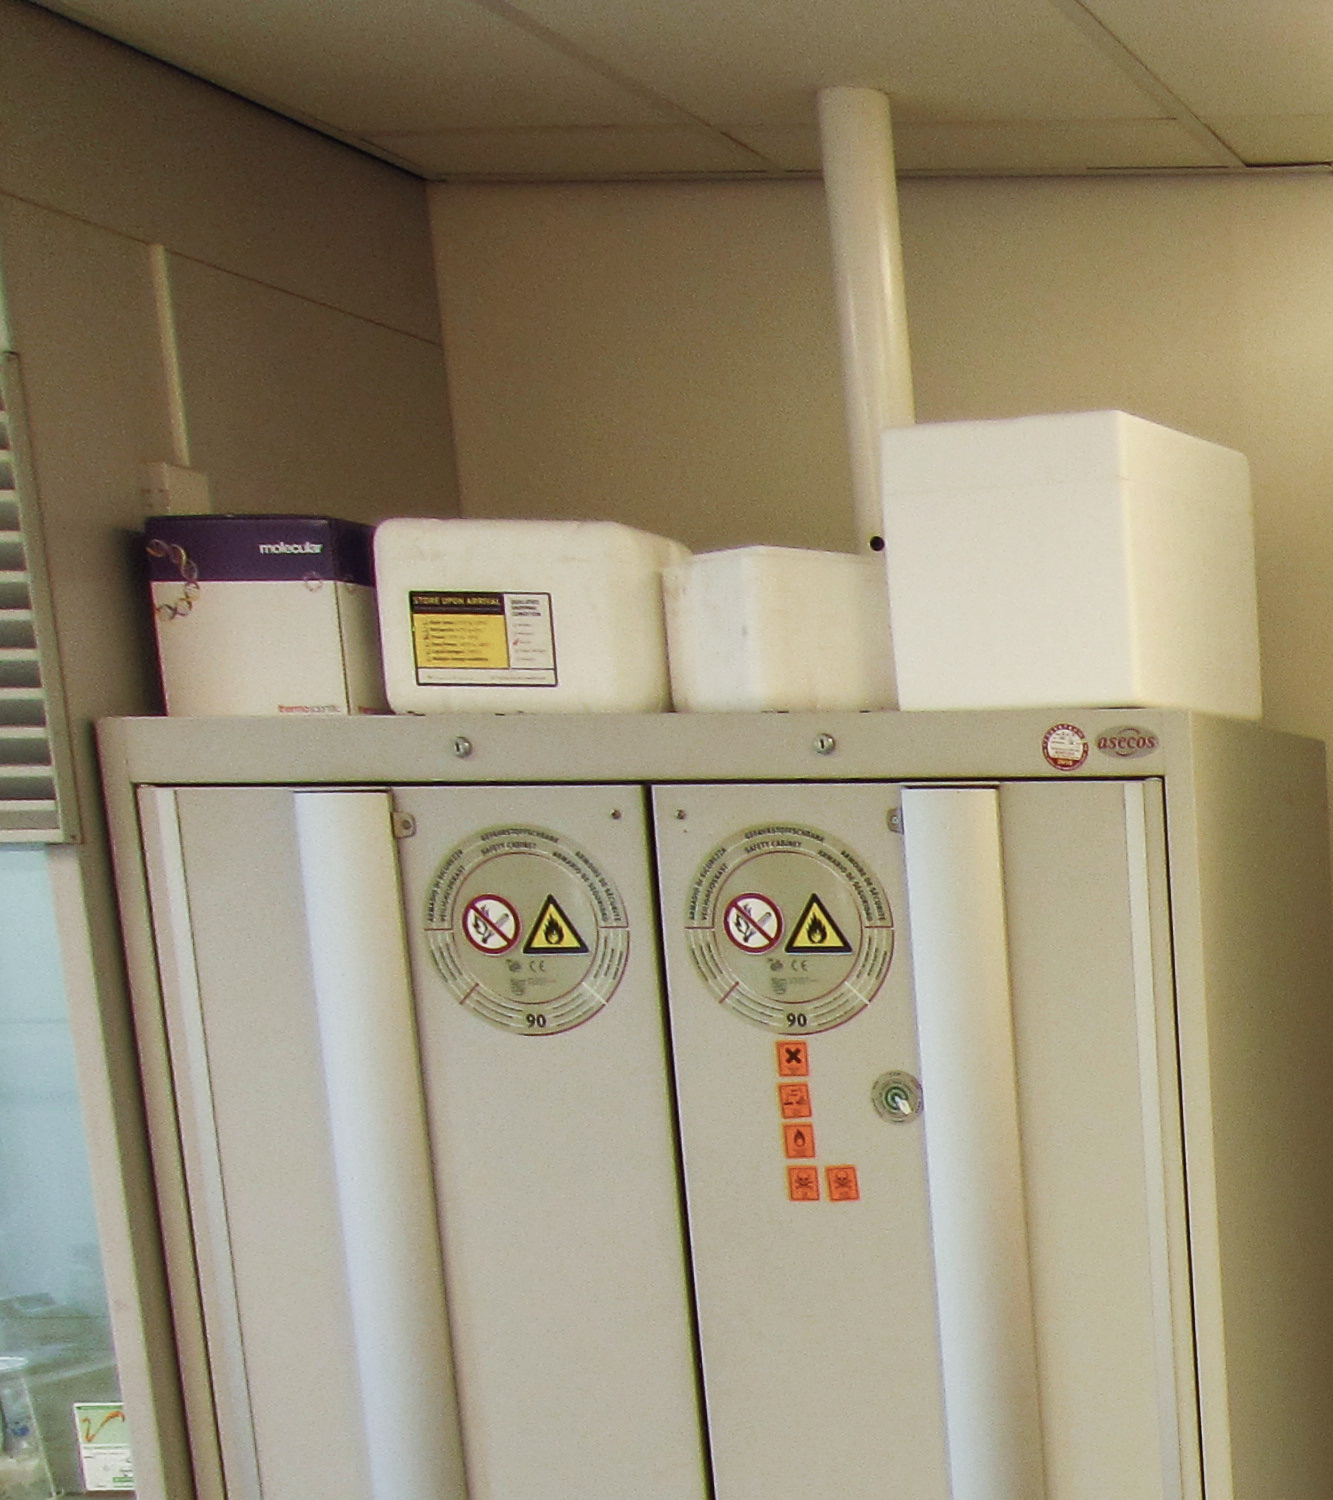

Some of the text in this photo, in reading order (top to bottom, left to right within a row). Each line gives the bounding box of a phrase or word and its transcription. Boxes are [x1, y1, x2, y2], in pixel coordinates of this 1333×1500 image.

[258, 541, 324, 555] molecular
[1097, 736, 1156, 750] asecos
[525, 1014, 547, 1028] 90
[786, 1012, 808, 1028] 90
